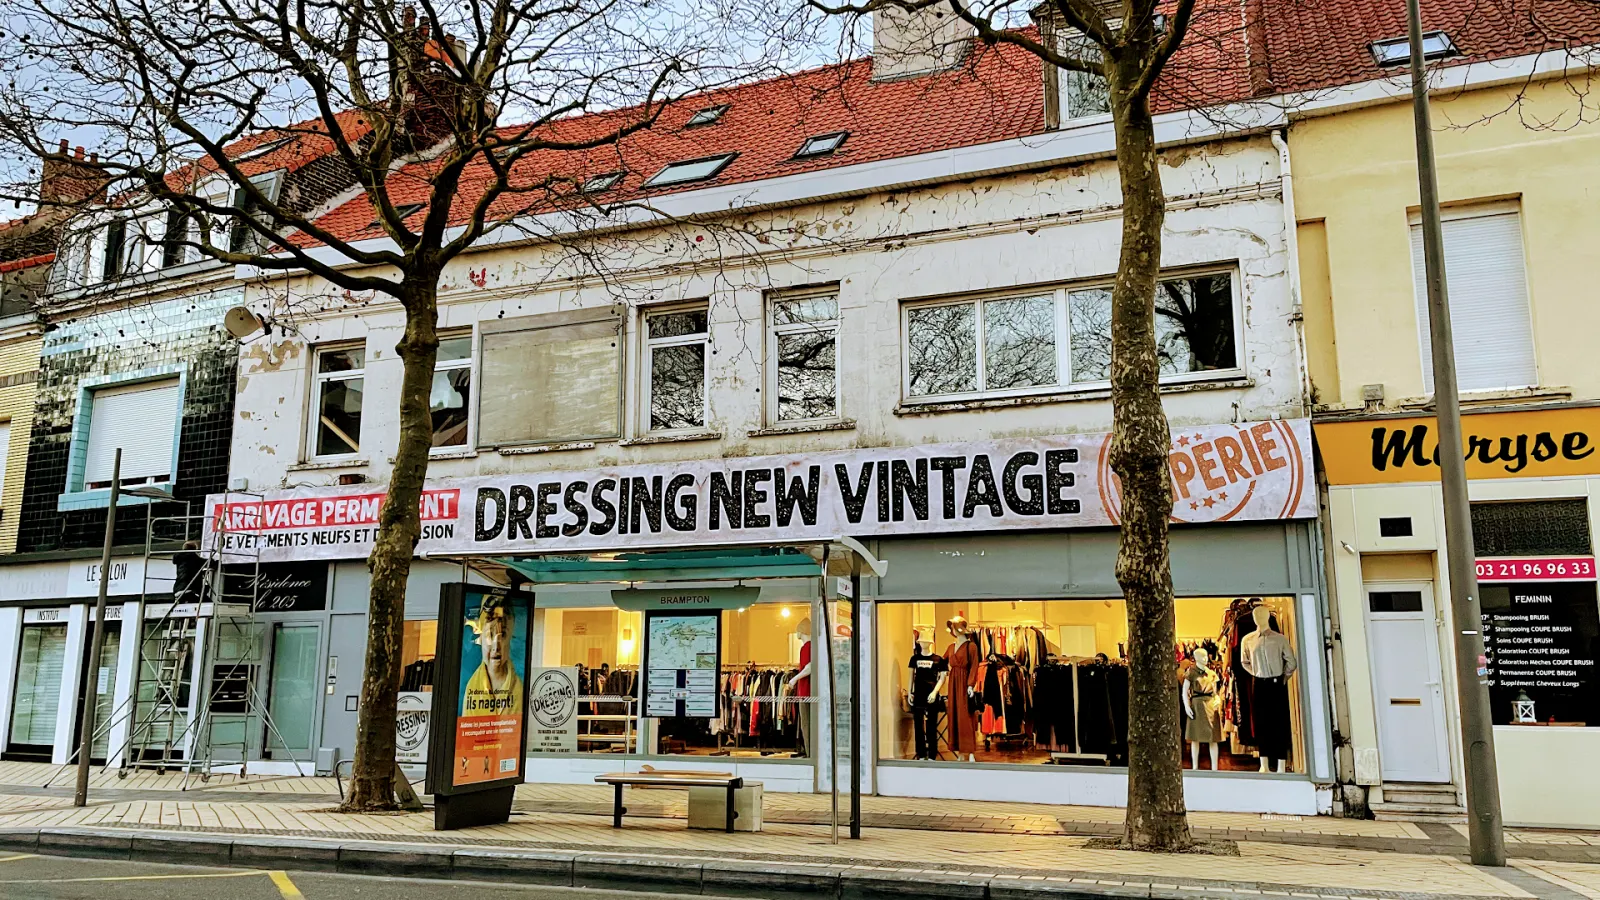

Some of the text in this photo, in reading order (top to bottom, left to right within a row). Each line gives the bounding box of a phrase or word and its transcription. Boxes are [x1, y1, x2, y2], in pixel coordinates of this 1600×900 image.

[1111, 421, 1287, 502] PERIE
[475, 449, 1080, 541] DRESSING NEW VINTAGE
[217, 493, 454, 530] ARRIVAGE PERMNT
[236, 532, 308, 549] VETMENTS
[312, 529, 351, 545] NEUFS
[354, 529, 370, 543] ET
[86, 563, 127, 581] LE SLON
[1475, 562, 1590, 576] 03 21 96 96 33
[239, 572, 311, 589] Résidence
[269, 595, 298, 609] 205
[660, 596, 710, 604] BRAMPTON
[1515, 595, 1552, 603] FEMININ
[37, 610, 59, 621] INSTITUT
[104, 607, 121, 618] FFURE
[467, 696, 476, 710] ils
[533, 685, 572, 712] DRESSING
[396, 710, 426, 733] RESSING
